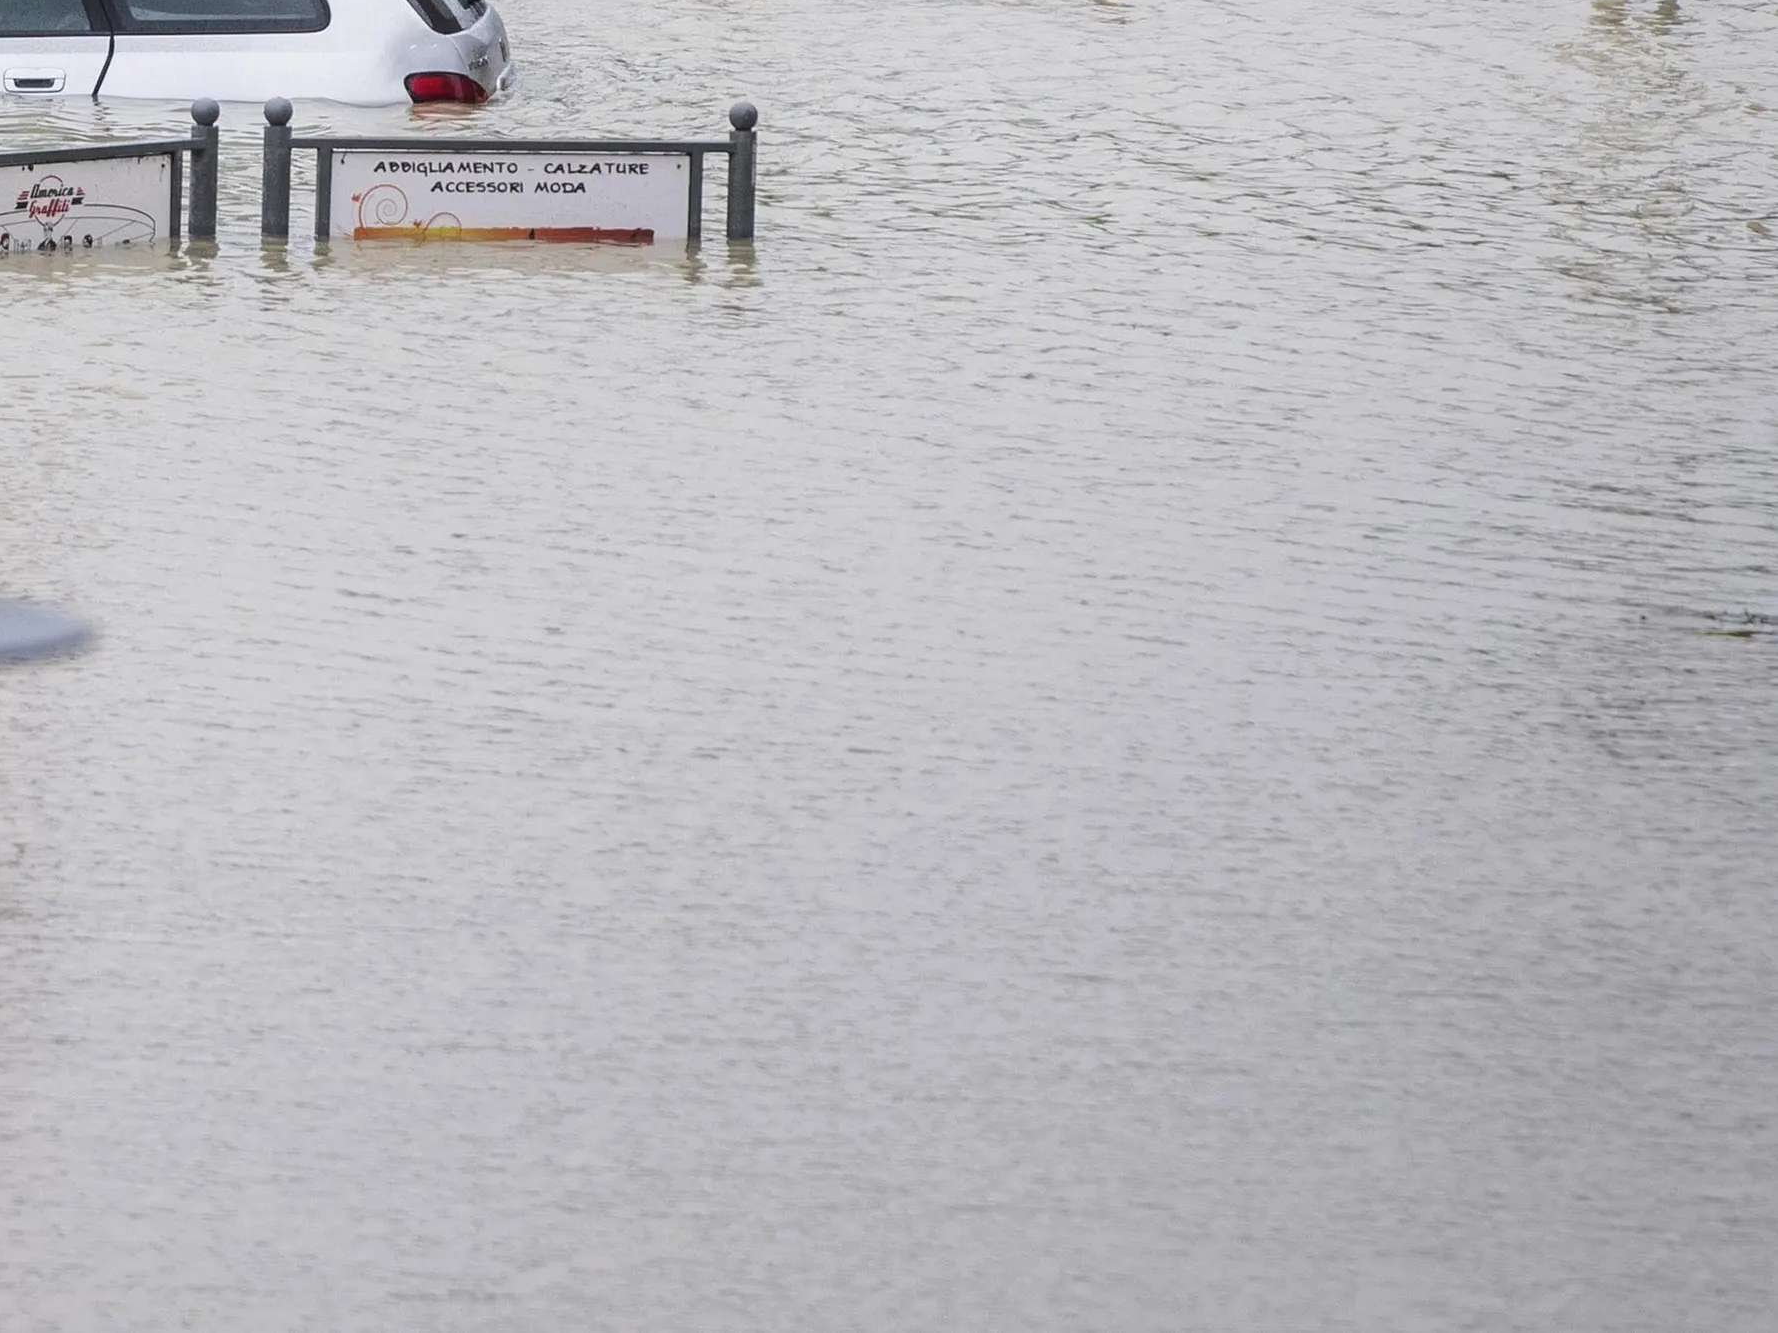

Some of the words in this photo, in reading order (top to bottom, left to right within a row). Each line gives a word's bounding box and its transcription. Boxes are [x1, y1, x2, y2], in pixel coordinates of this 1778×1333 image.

[373, 161, 518, 177] ABBIGLIAMENTO
[543, 162, 649, 175] CALZATURE
[30, 183, 75, 199] America
[430, 181, 524, 194] ACCESSORI
[534, 181, 587, 194] MODA
[28, 199, 71, 219] Graffiti
